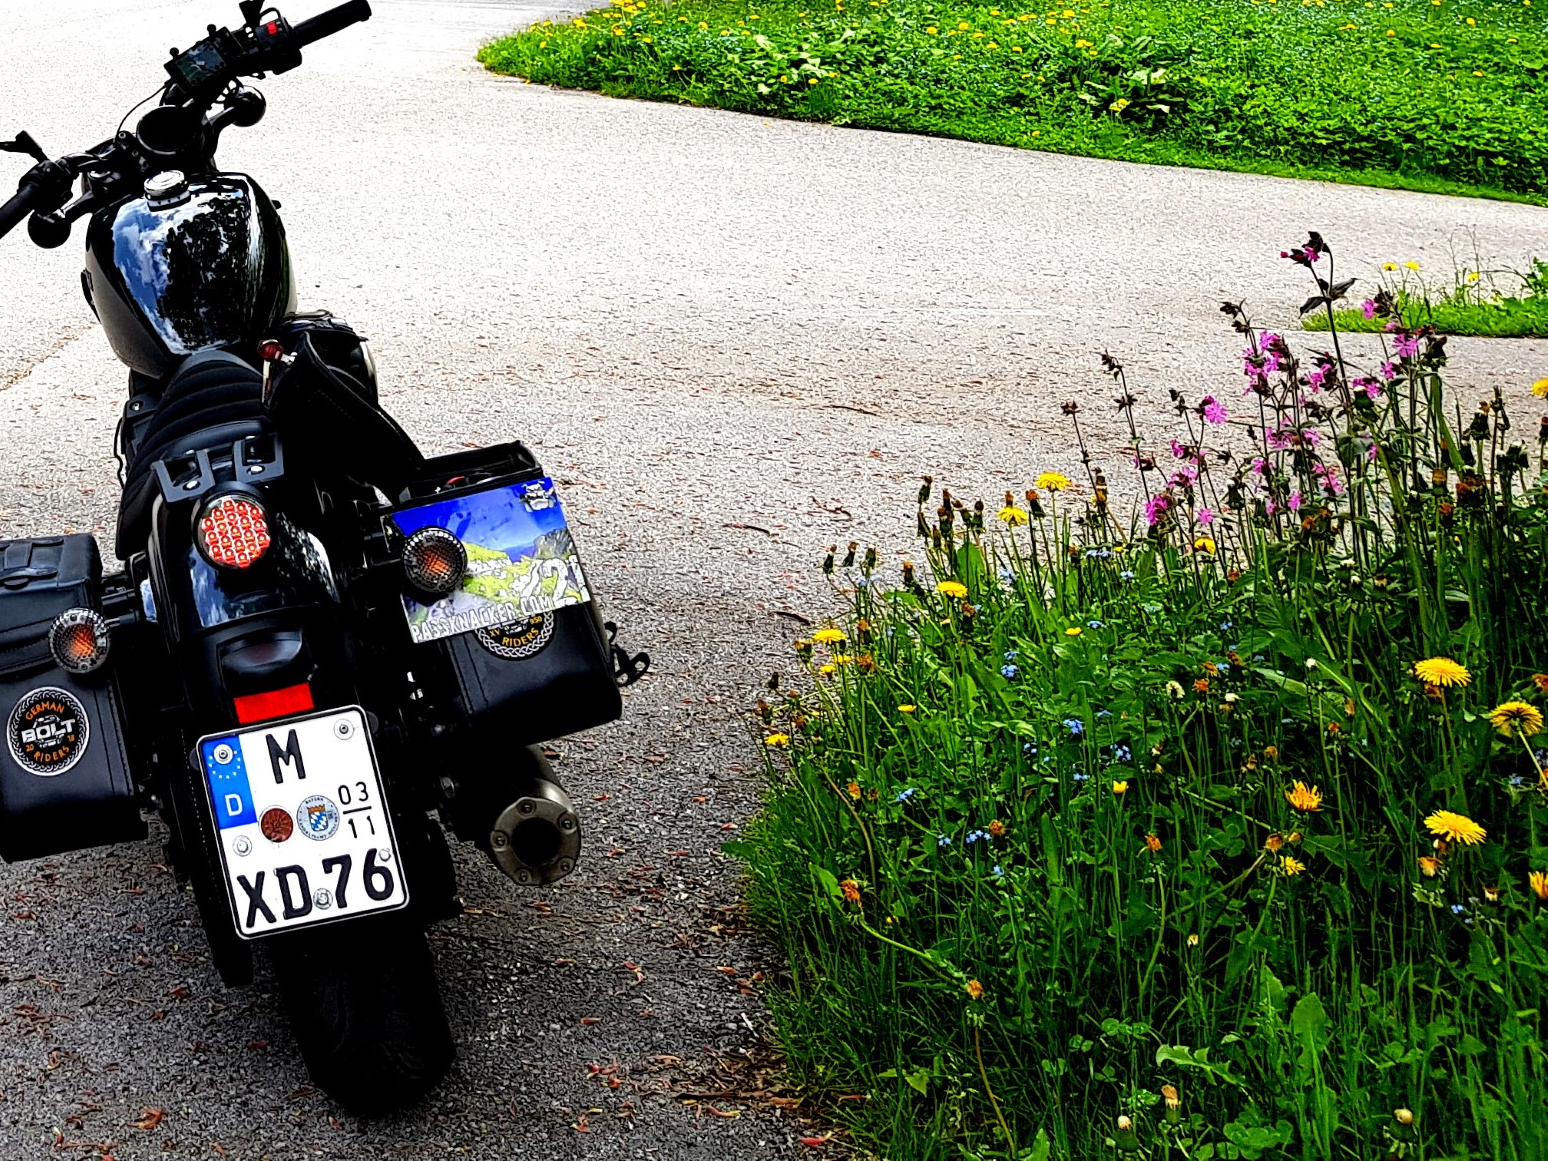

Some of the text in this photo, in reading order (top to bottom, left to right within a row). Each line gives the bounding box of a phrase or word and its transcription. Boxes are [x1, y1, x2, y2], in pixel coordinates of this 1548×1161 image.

[501, 627, 539, 647] RIDERS
[25, 700, 65, 720] GERMAN
[21, 719, 75, 743] BOLT
[33, 745, 70, 762] RIDERS
[265, 728, 306, 784] M
[224, 793, 243, 817] D
[337, 781, 369, 805] 03
[348, 815, 375, 839] 11
[236, 847, 395, 928] XD 76
